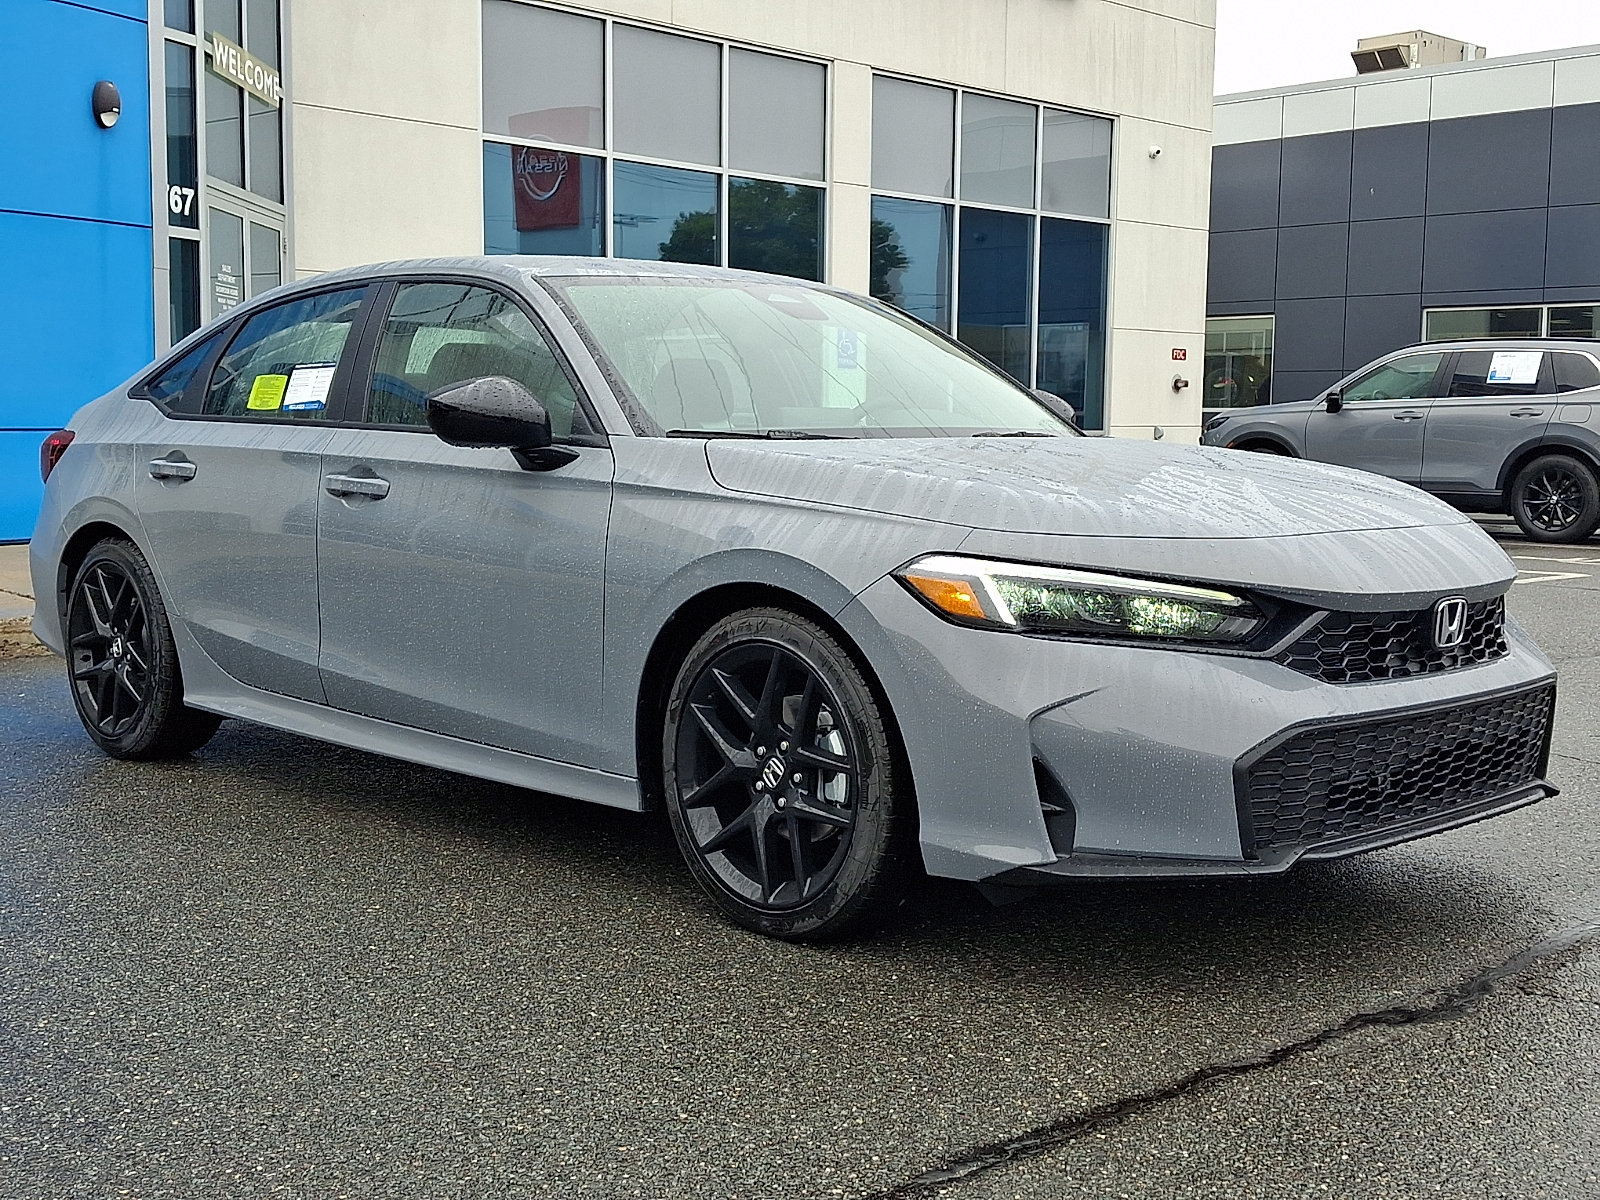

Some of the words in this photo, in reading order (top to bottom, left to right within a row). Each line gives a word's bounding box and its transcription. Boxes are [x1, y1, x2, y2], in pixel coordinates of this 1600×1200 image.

[213, 37, 279, 102] WELCOME
[166, 184, 195, 216] 67
[1173, 349, 1186, 360] FDC
